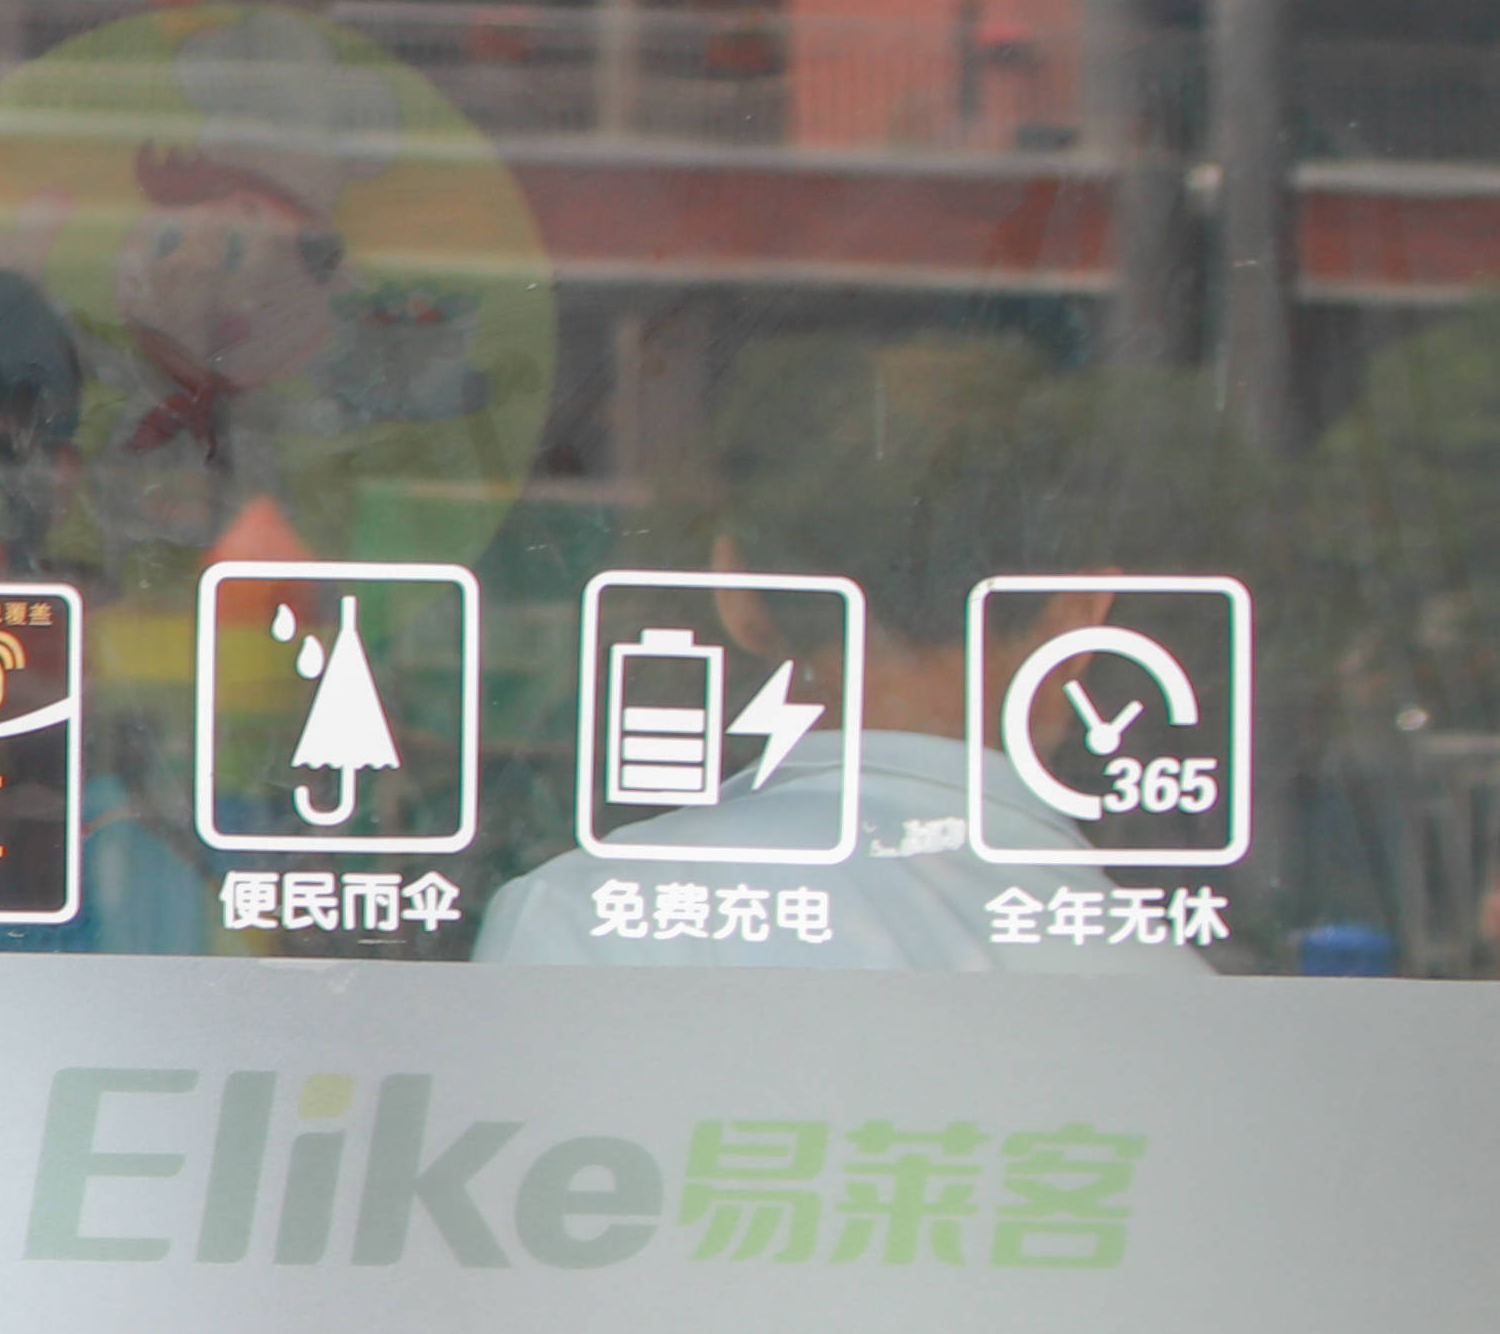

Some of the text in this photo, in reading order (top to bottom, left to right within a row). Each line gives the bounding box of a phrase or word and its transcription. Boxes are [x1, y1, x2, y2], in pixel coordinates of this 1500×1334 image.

[1102, 758, 1218, 814] 365
[219, 870, 461, 931] 便民雨伞
[590, 878, 834, 944] 免费充电
[984, 886, 1231, 946] 全年无休
[22, 1066, 1150, 1270] Elike 易莱客
